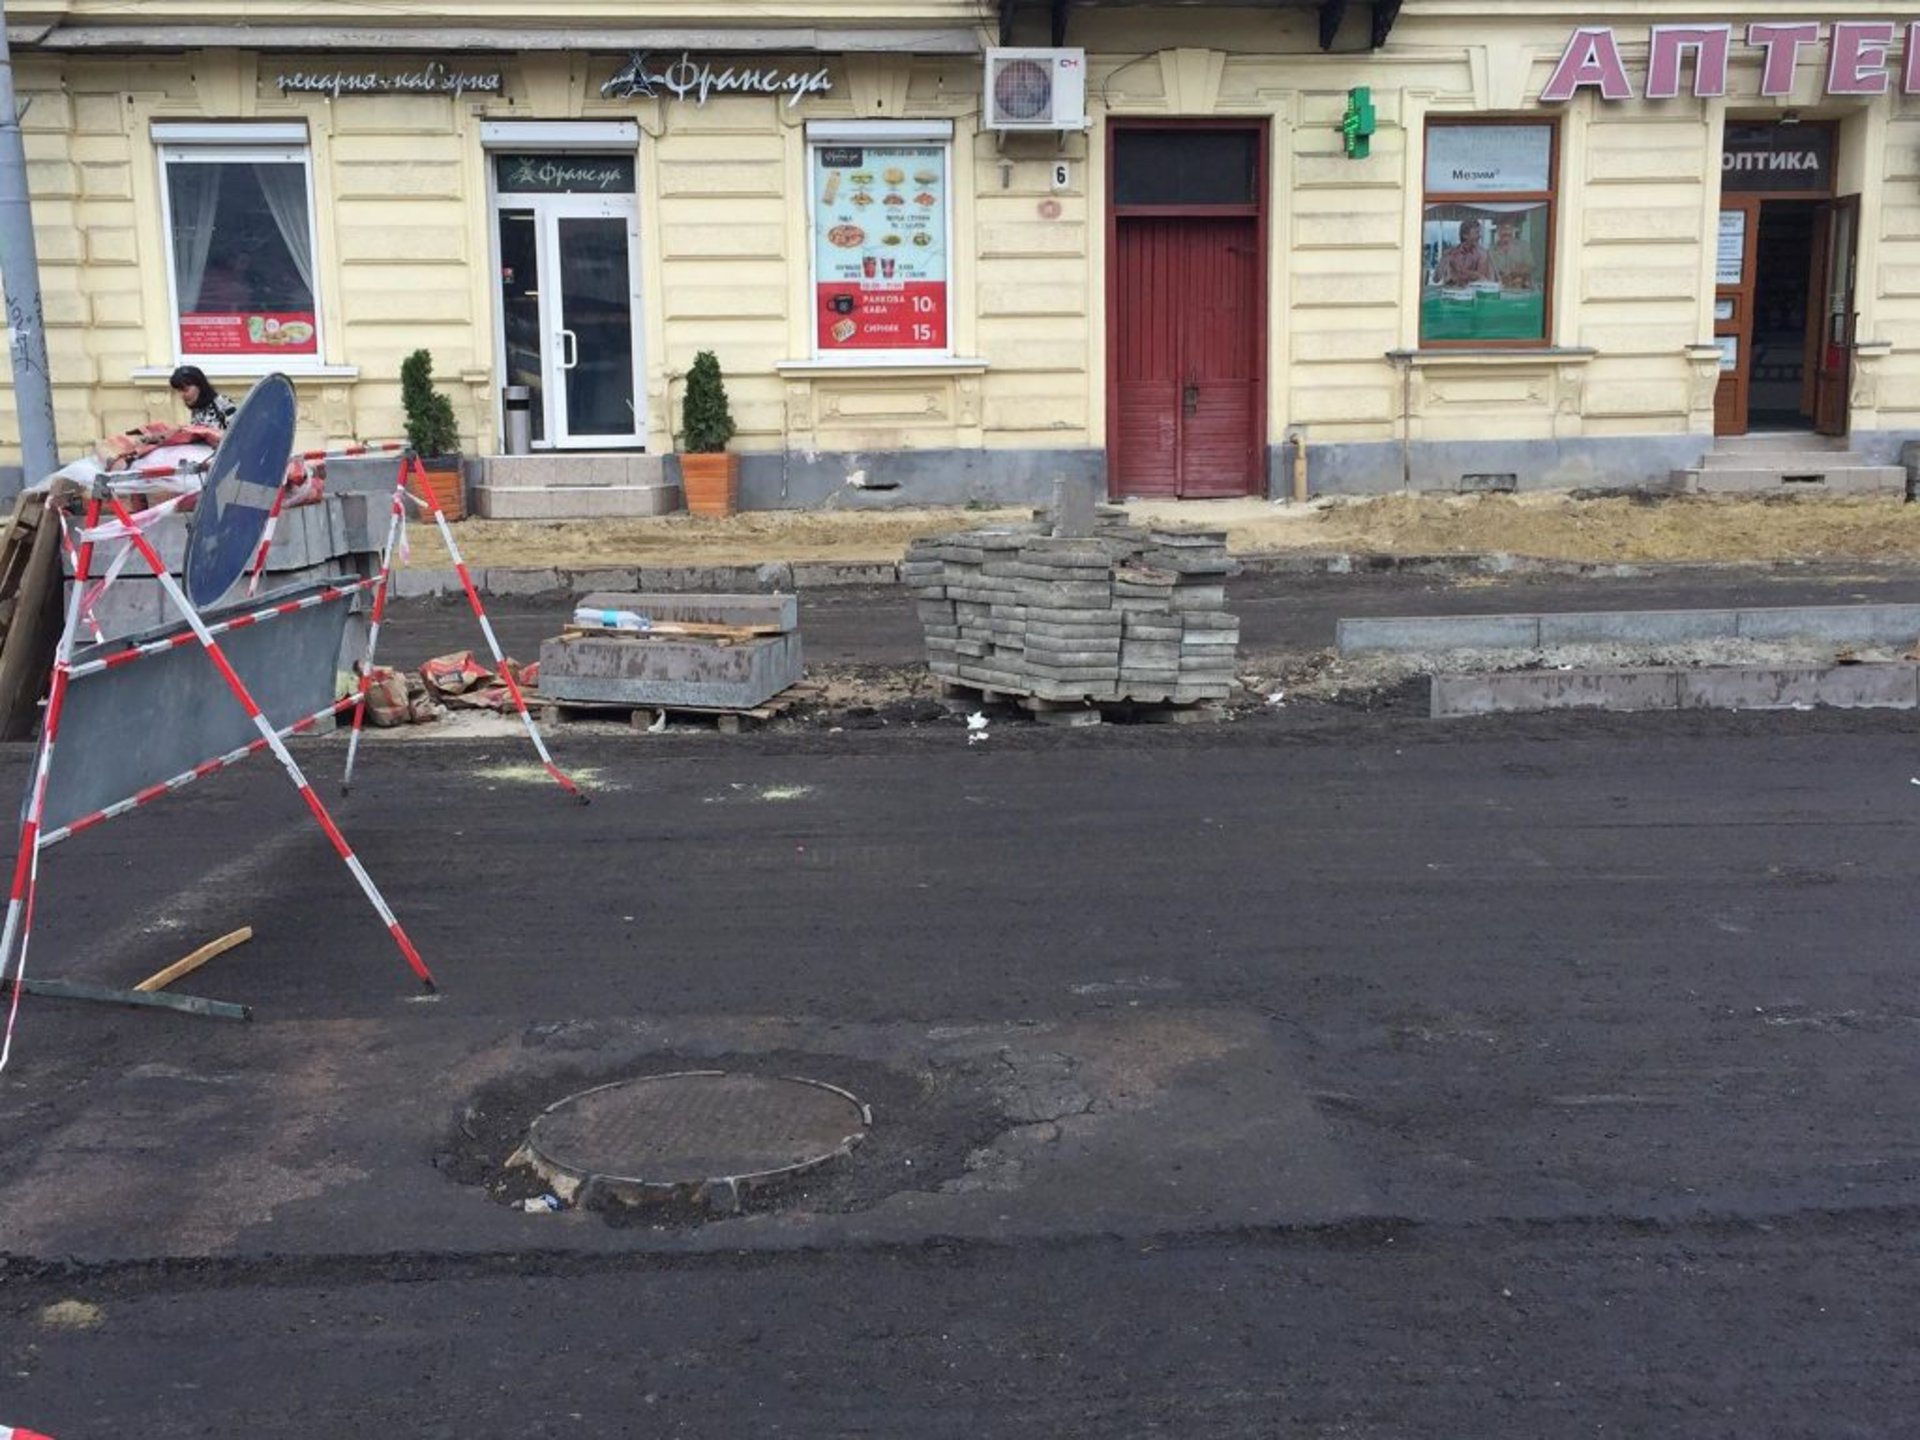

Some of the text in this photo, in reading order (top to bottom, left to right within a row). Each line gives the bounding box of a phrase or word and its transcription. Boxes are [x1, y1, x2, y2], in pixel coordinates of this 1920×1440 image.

[1538, 22, 1920, 101] АПТЕ
[277, 71, 377, 98] пекарня
[1721, 151, 1820, 171] ОПТИКА
[1056, 166, 1066, 184] 6
[911, 296, 933, 313] 10
[911, 323, 931, 341] 15
